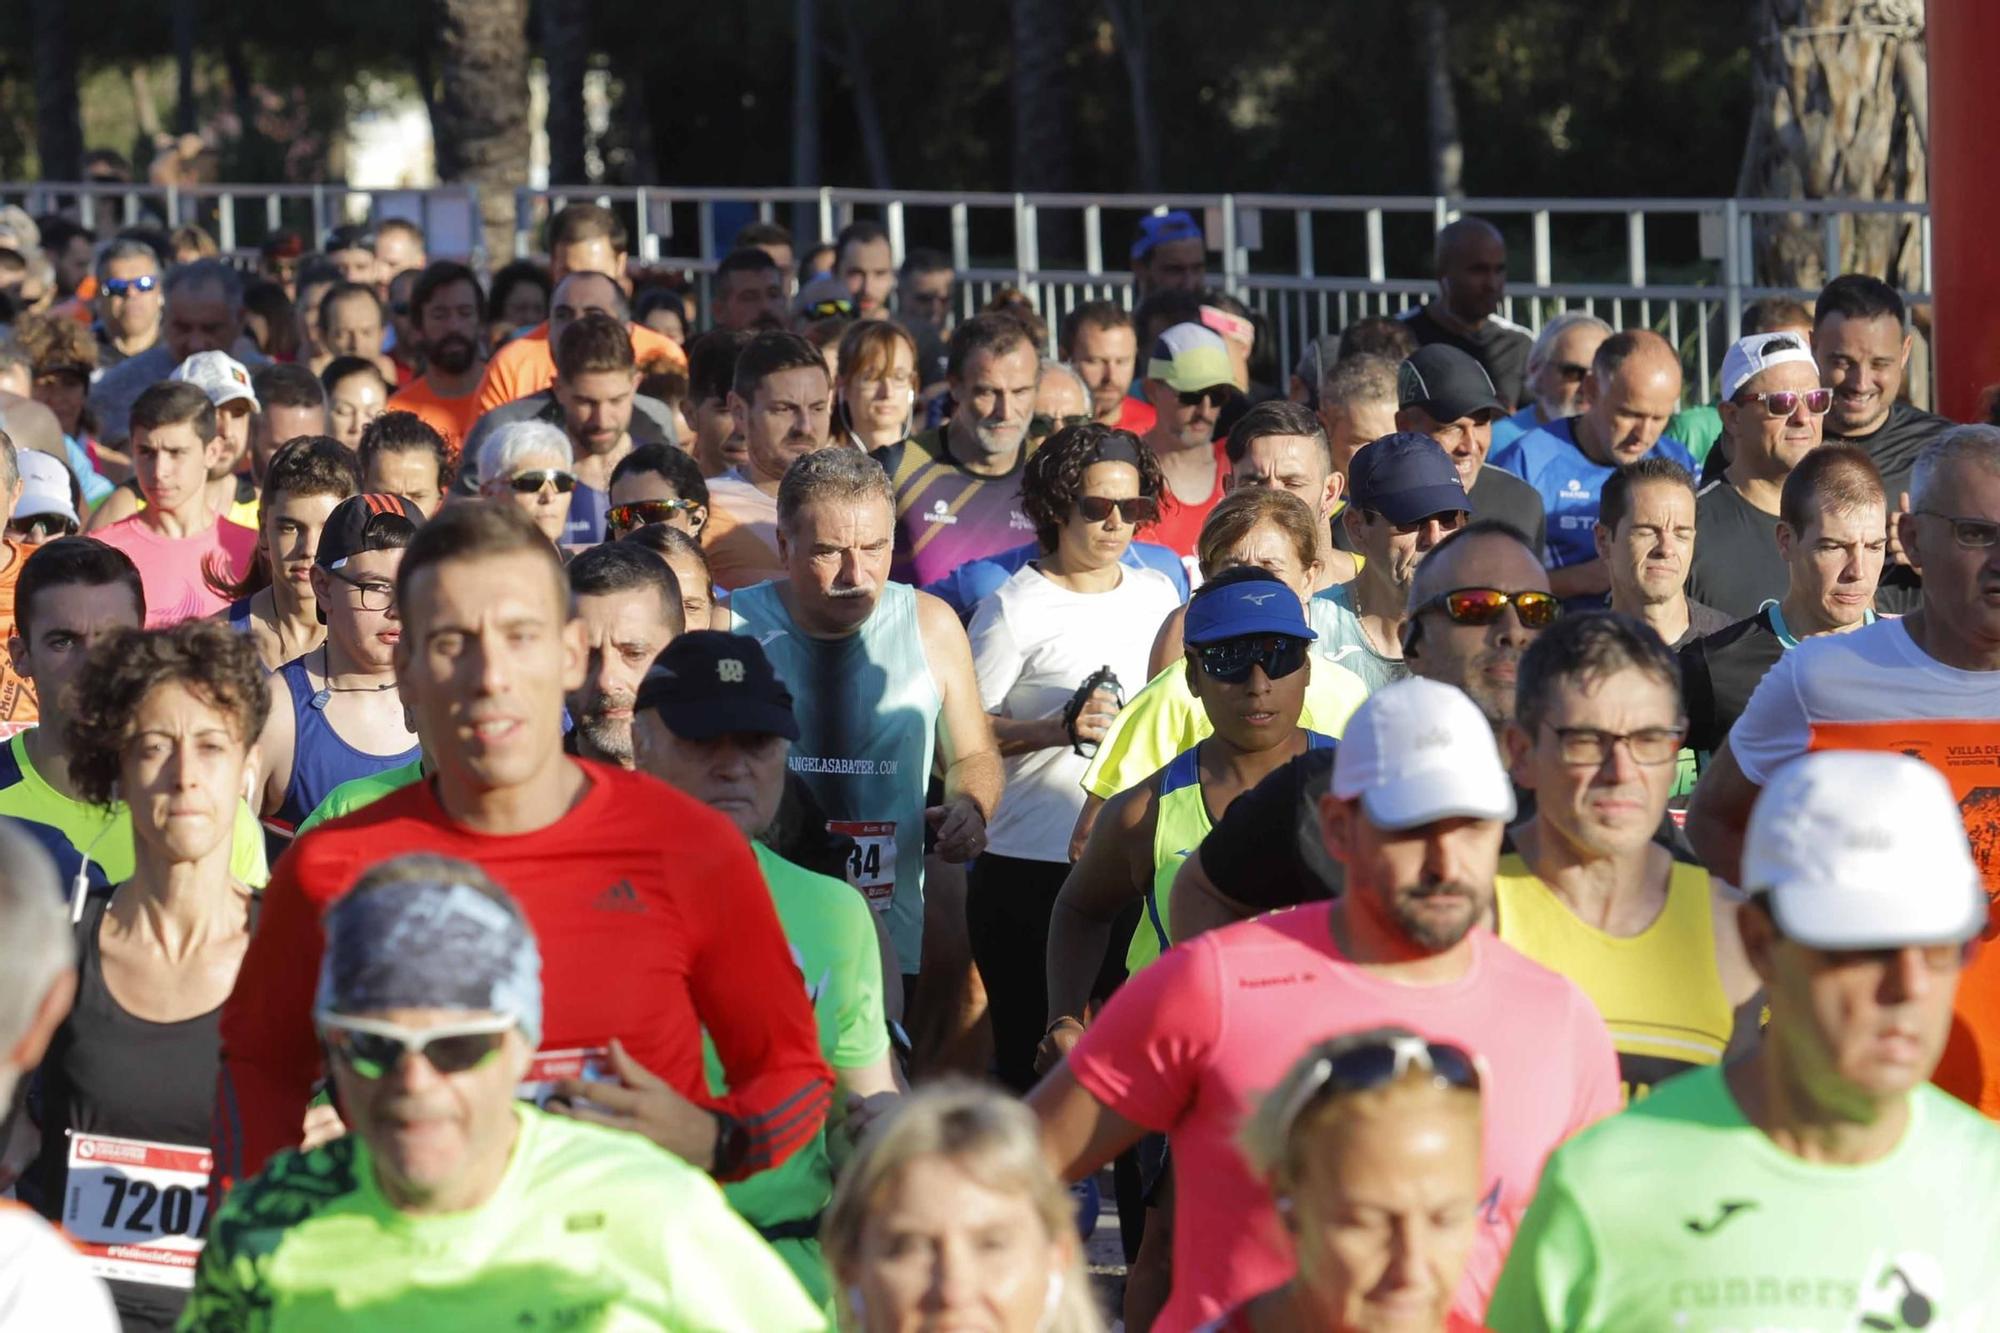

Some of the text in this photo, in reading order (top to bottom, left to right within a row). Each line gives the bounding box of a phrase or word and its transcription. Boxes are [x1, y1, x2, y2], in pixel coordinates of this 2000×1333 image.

[1946, 745, 1983, 756] VILLA
[788, 756, 899, 776] ANGELASABATER.COM
[849, 843, 880, 880] 34
[1669, 1276, 1857, 1309] runners
